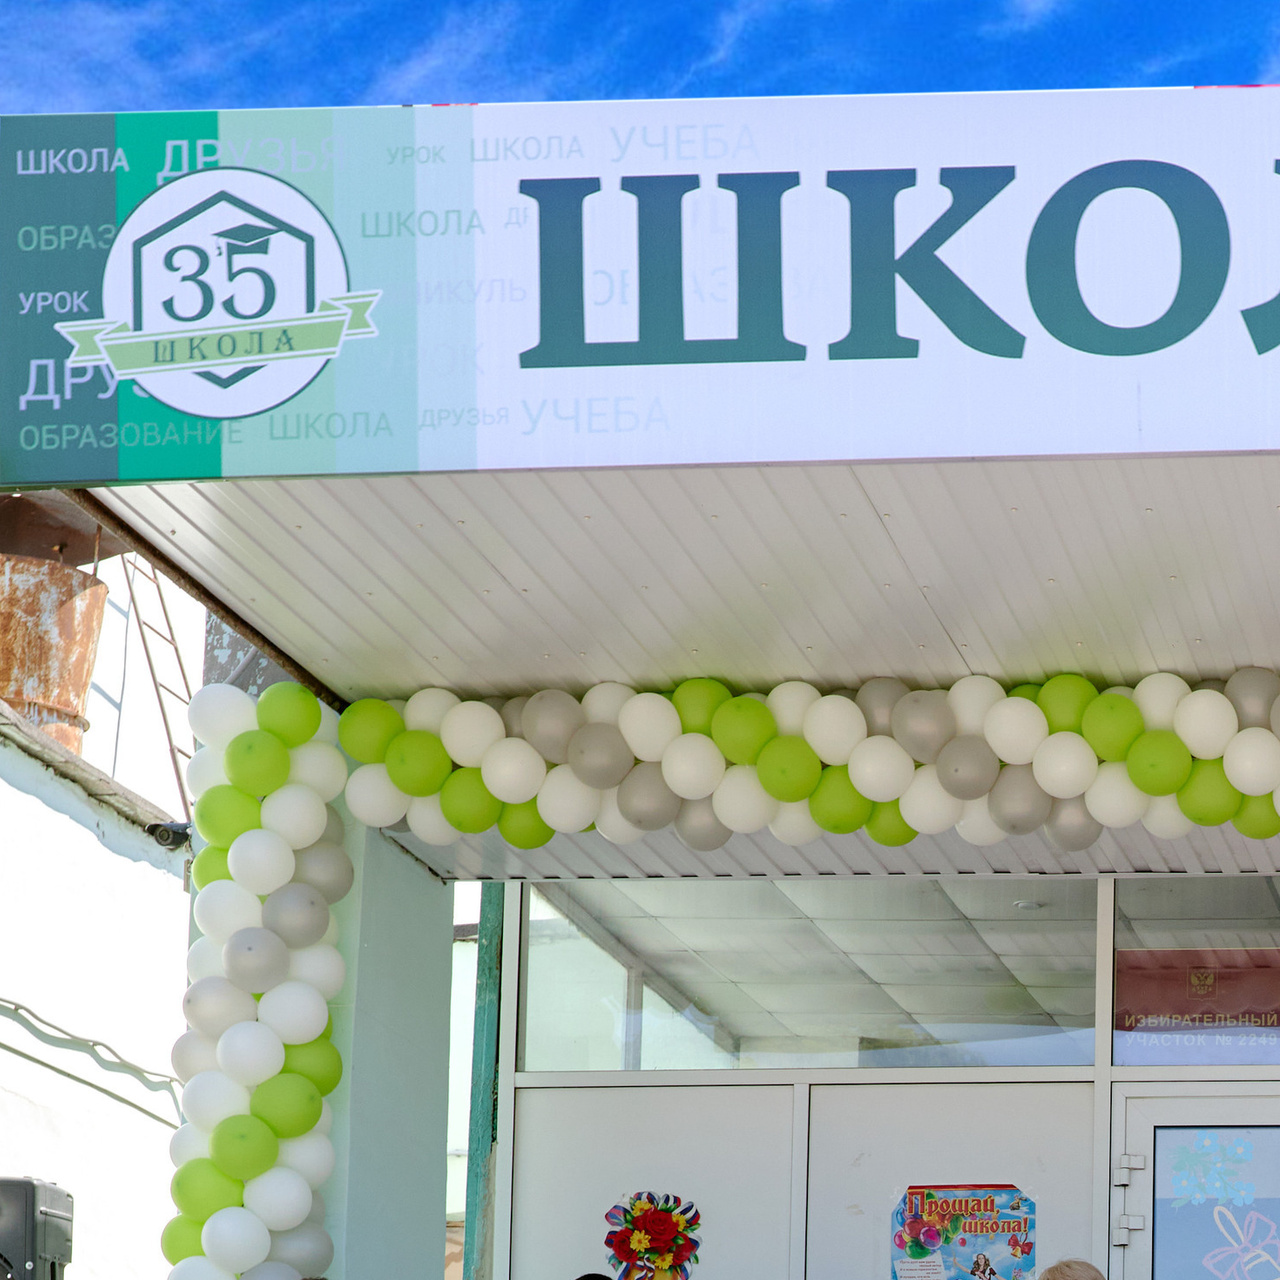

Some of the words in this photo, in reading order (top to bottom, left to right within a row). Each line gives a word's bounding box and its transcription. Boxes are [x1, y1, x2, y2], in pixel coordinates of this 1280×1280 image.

[386, 145, 446, 166] УРОК
[470, 135, 584, 163] ШКОЛА
[609, 123, 761, 164] УЧЕБА
[17, 147, 129, 176] ШКОЛА
[360, 209, 486, 239] ШКОЛА
[161, 244, 276, 322] 35
[18, 290, 90, 315] УРОК
[152, 329, 295, 364] ШКОЛА
[19, 419, 244, 451] ОБРАЗОВАНИЕ
[268, 410, 393, 442] ШКОЛА
[418, 405, 509, 430] ДРУЗЬЯ
[520, 396, 672, 437] УЧЕБА
[1125, 1011, 1278, 1028] ИЗБИРАТЕЛЬНЫЙ
[1125, 1034, 1207, 1047] УЧАСТОК
[1215, 1034, 1232, 1046] №
[1238, 1033, 1278, 1047] 2249
[907, 1190, 1000, 1216] Прощай,
[961, 1217, 1029, 1235] школа!
